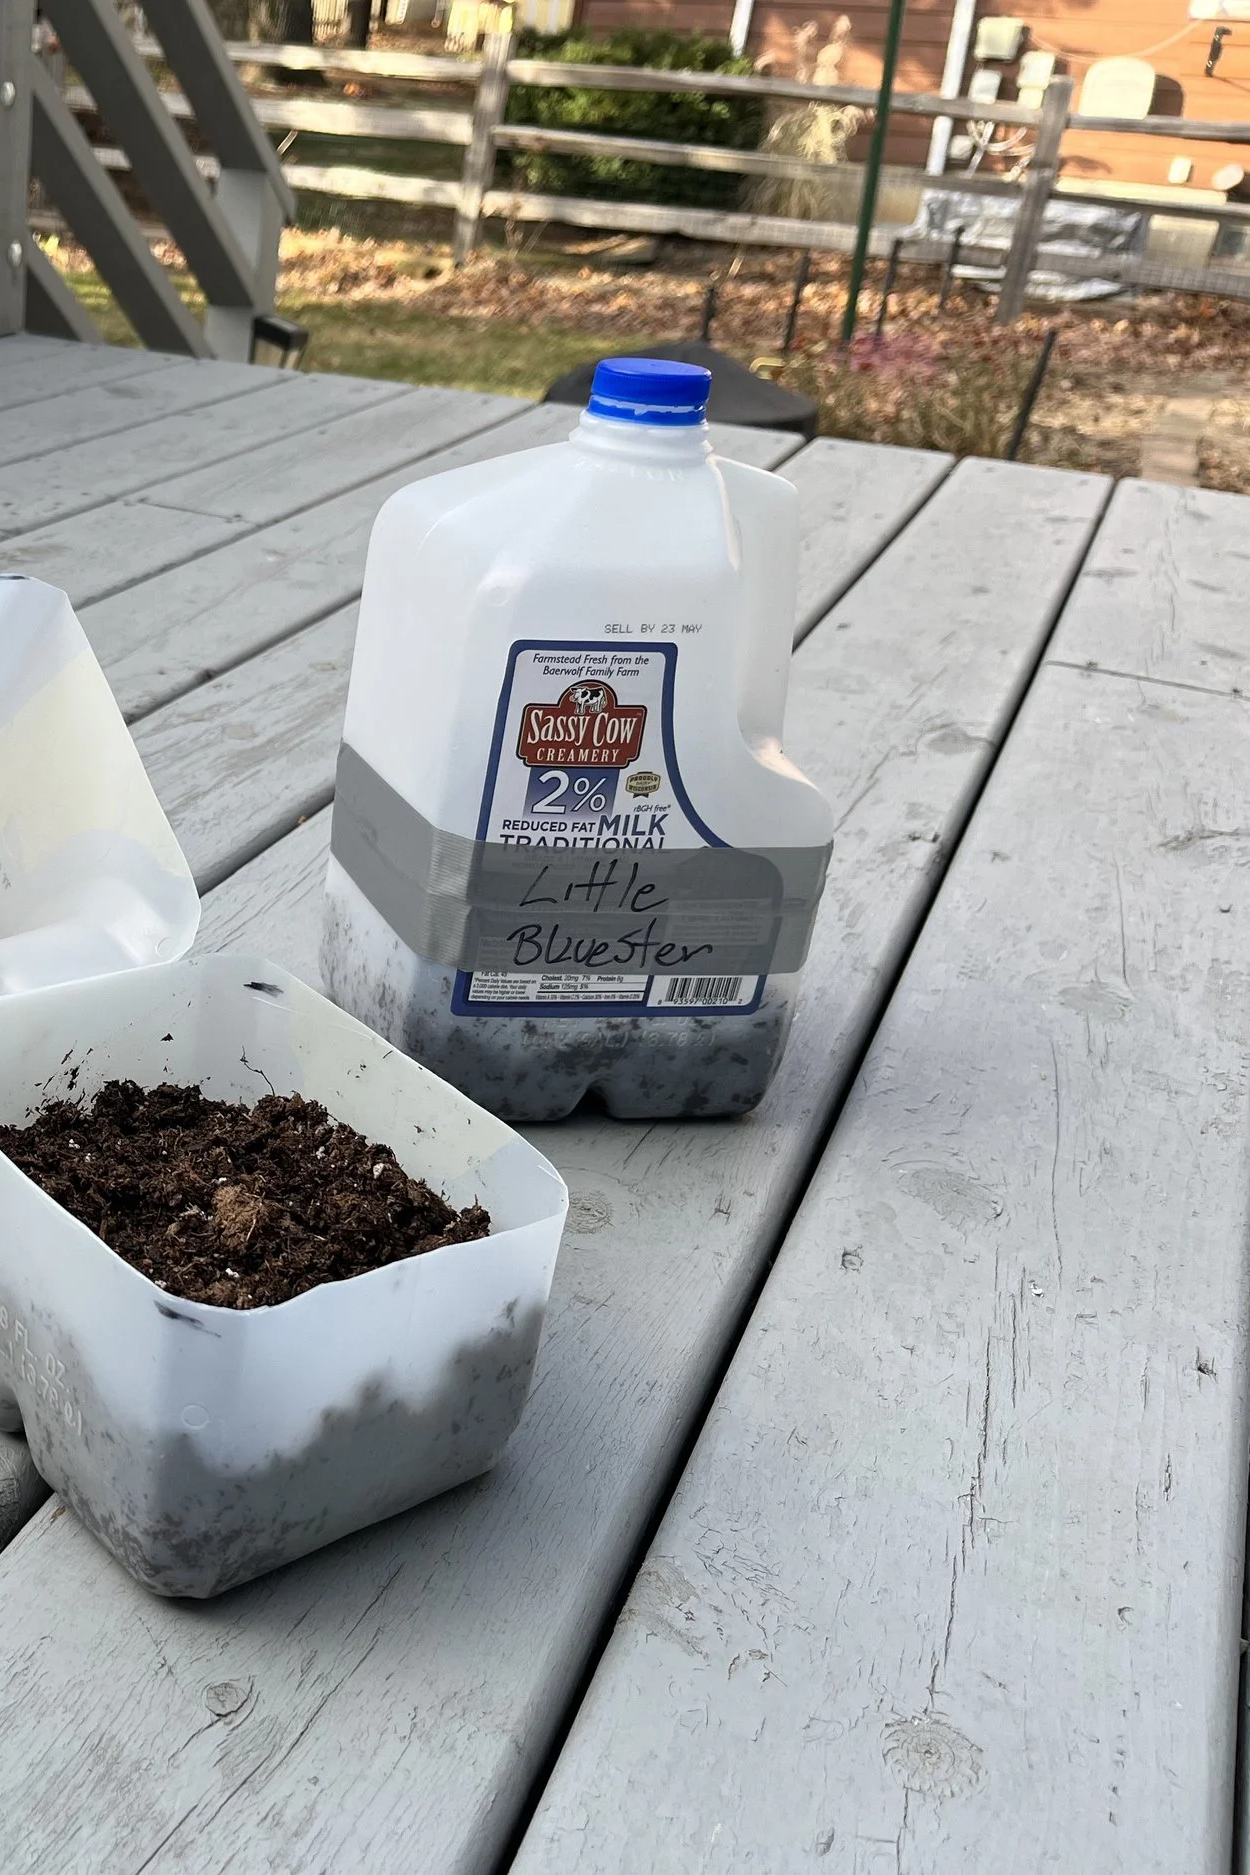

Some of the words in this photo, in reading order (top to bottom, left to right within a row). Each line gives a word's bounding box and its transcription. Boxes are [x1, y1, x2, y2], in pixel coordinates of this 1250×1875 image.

[604, 624, 632, 634] SELL
[640, 624, 655, 633] BY
[661, 624, 676, 633] 23
[681, 624, 702, 633] MAY
[533, 653, 582, 664] Farmstead
[584, 654, 607, 664] Fresh
[610, 655, 632, 666] from
[635, 655, 649, 665] the
[543, 665, 584, 678] Baerwolf
[585, 666, 614, 678] Family
[616, 667, 639, 676] Farm
[527, 709, 591, 746] Sassy
[593, 712, 637, 747] Cow
[536, 747, 620, 763] CREAMERY
[530, 769, 607, 814] 2%
[502, 819, 568, 832] REDUCED
[571, 821, 596, 833] FAT
[597, 813, 669, 837] MILK
[519, 858, 669, 913] Little
[14, 1318, 39, 1363] FL.
